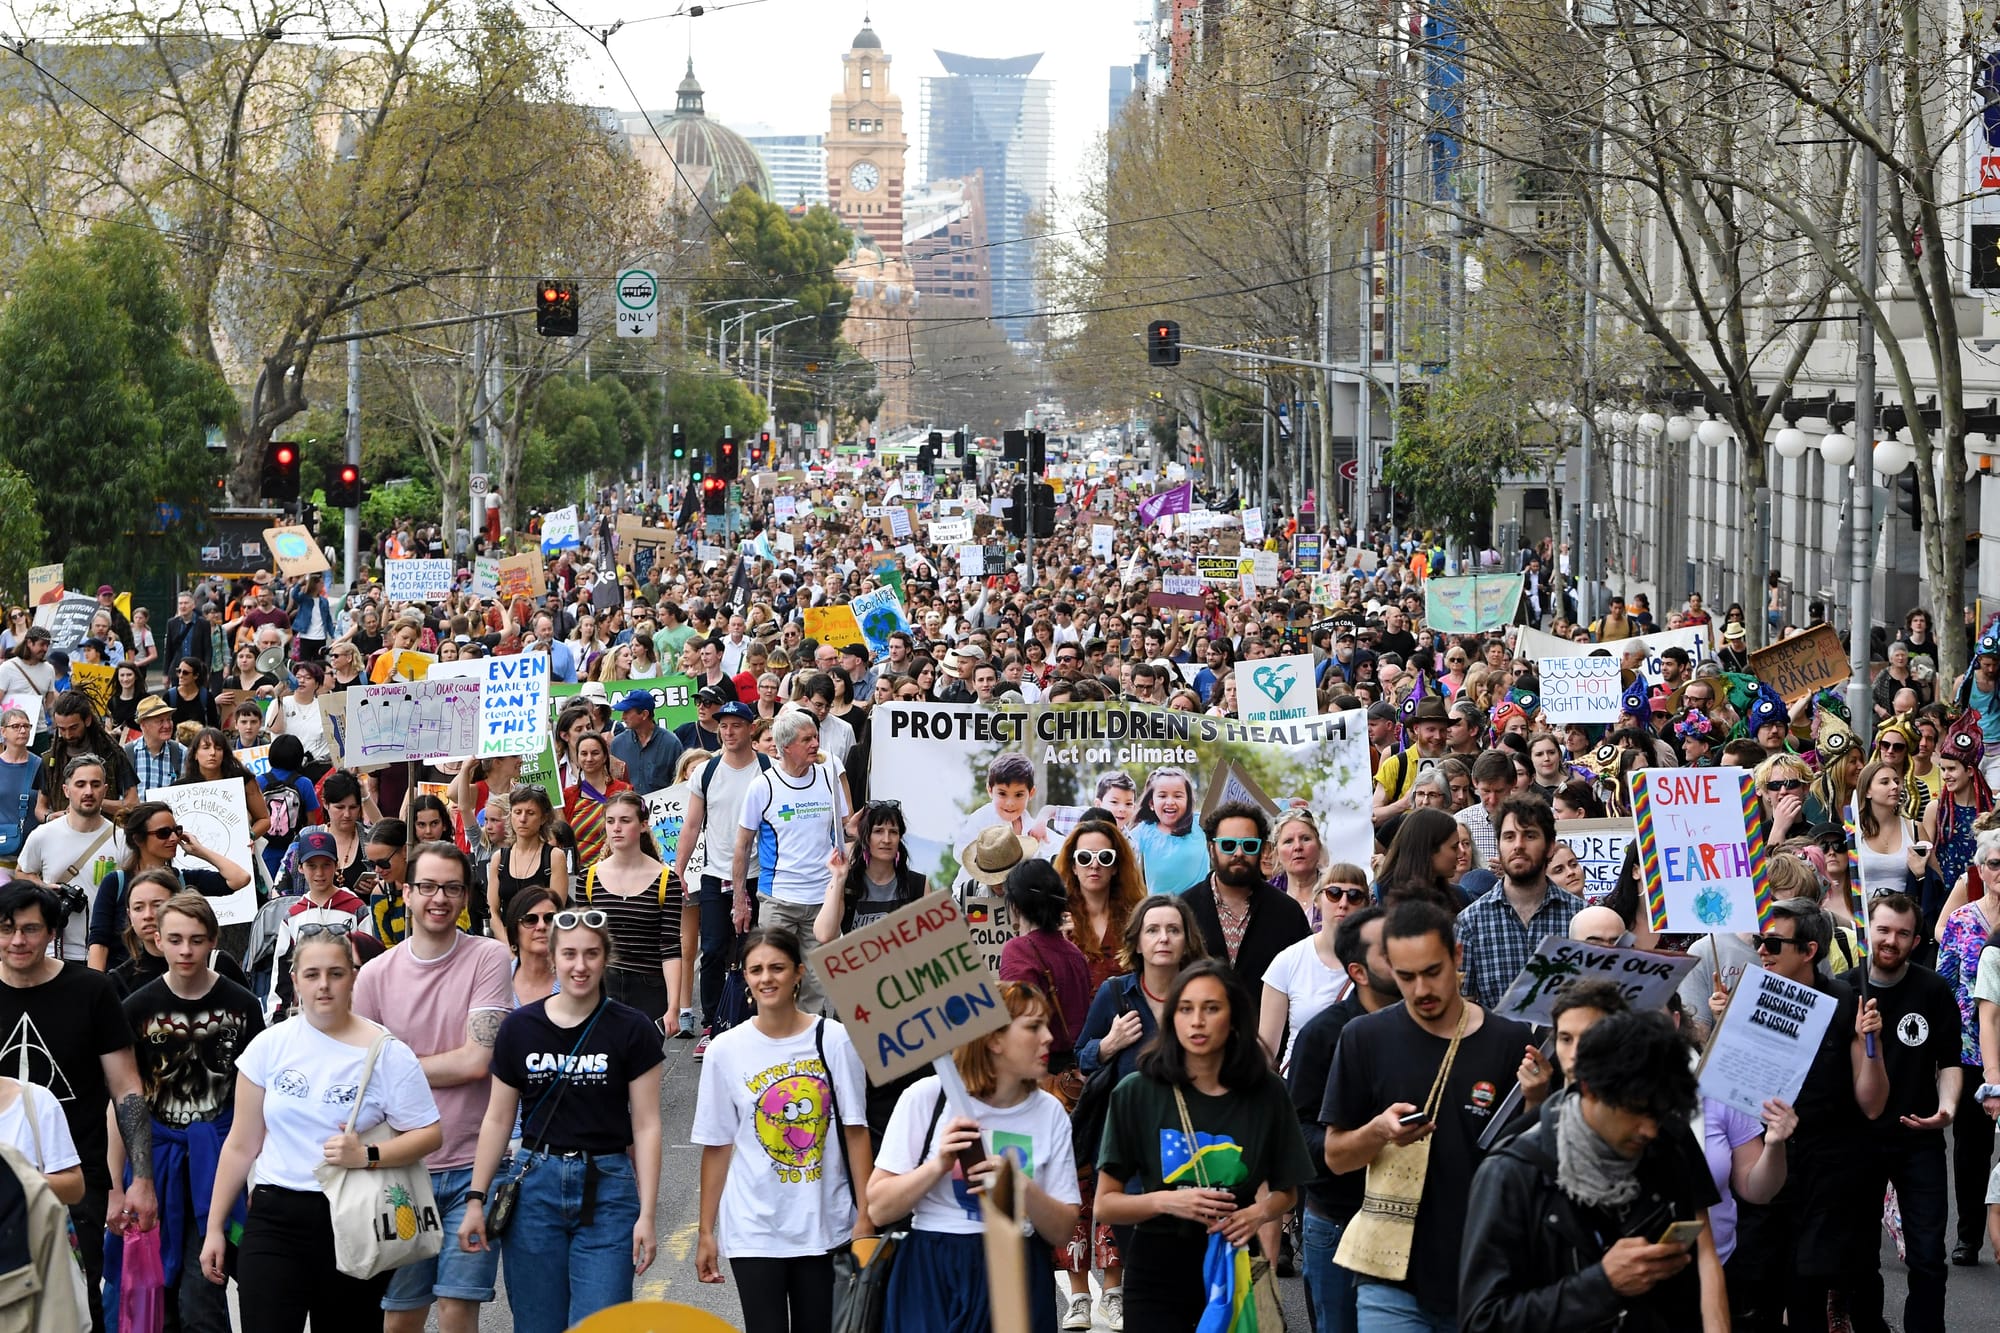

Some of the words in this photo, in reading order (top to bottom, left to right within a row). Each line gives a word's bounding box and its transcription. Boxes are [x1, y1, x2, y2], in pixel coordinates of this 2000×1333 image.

[619, 312, 653, 322] ONLY
[472, 481, 485, 489] 40
[550, 525, 575, 534] RISE
[423, 561, 450, 570] SHALL
[391, 572, 413, 581] NOT
[416, 571, 451, 580] EXCEED
[412, 581, 433, 590] PARTS
[434, 581, 448, 590] PER
[1759, 637, 1816, 669] ICEBERGS
[490, 655, 546, 680] EVEN
[1542, 658, 1569, 670] THE
[1574, 657, 1619, 669] OCEAN
[1777, 658, 1800, 675] ARE
[1542, 679, 1569, 696] SO
[1576, 678, 1612, 694] HOT
[485, 692, 540, 709] CAN'T
[1541, 697, 1584, 712] RIGHT
[1588, 695, 1619, 711] NOW
[1269, 706, 1307, 721] CLIMATE
[488, 717, 537, 735] THIS
[891, 710, 1028, 742] PROTECT
[1037, 710, 1218, 743] CHILDREN'S
[1226, 716, 1347, 745] HEALTH
[483, 735, 545, 754] MESS!!
[1043, 744, 1079, 764] Act
[1085, 748, 1111, 763] on
[1117, 744, 1197, 764] climate
[221, 790, 233, 803] THE
[1655, 775, 1721, 805] SAVE
[1666, 813, 1712, 839] The
[1663, 841, 1752, 883] EARTH
[824, 900, 957, 980] REDHEADS
[1551, 946, 1619, 972] SAVE
[1622, 957, 1675, 980] OUR
[854, 1003, 871, 1024] 4
[876, 941, 982, 1010] CLIMATE
[1759, 974, 1787, 995] THIS
[1783, 984, 1797, 999] IS
[1796, 989, 1819, 1008] NOT
[1756, 992, 1808, 1023] BUSINESS
[877, 983, 996, 1068] ACTION
[1749, 1008, 1767, 1027] AS
[1766, 1015, 1800, 1040] USUAL
[1917, 1016, 1928, 1030] CITY
[525, 1052, 609, 1074] CAIRNS
[746, 1062, 789, 1095] WE'RE
[777, 1169, 802, 1183] TO
